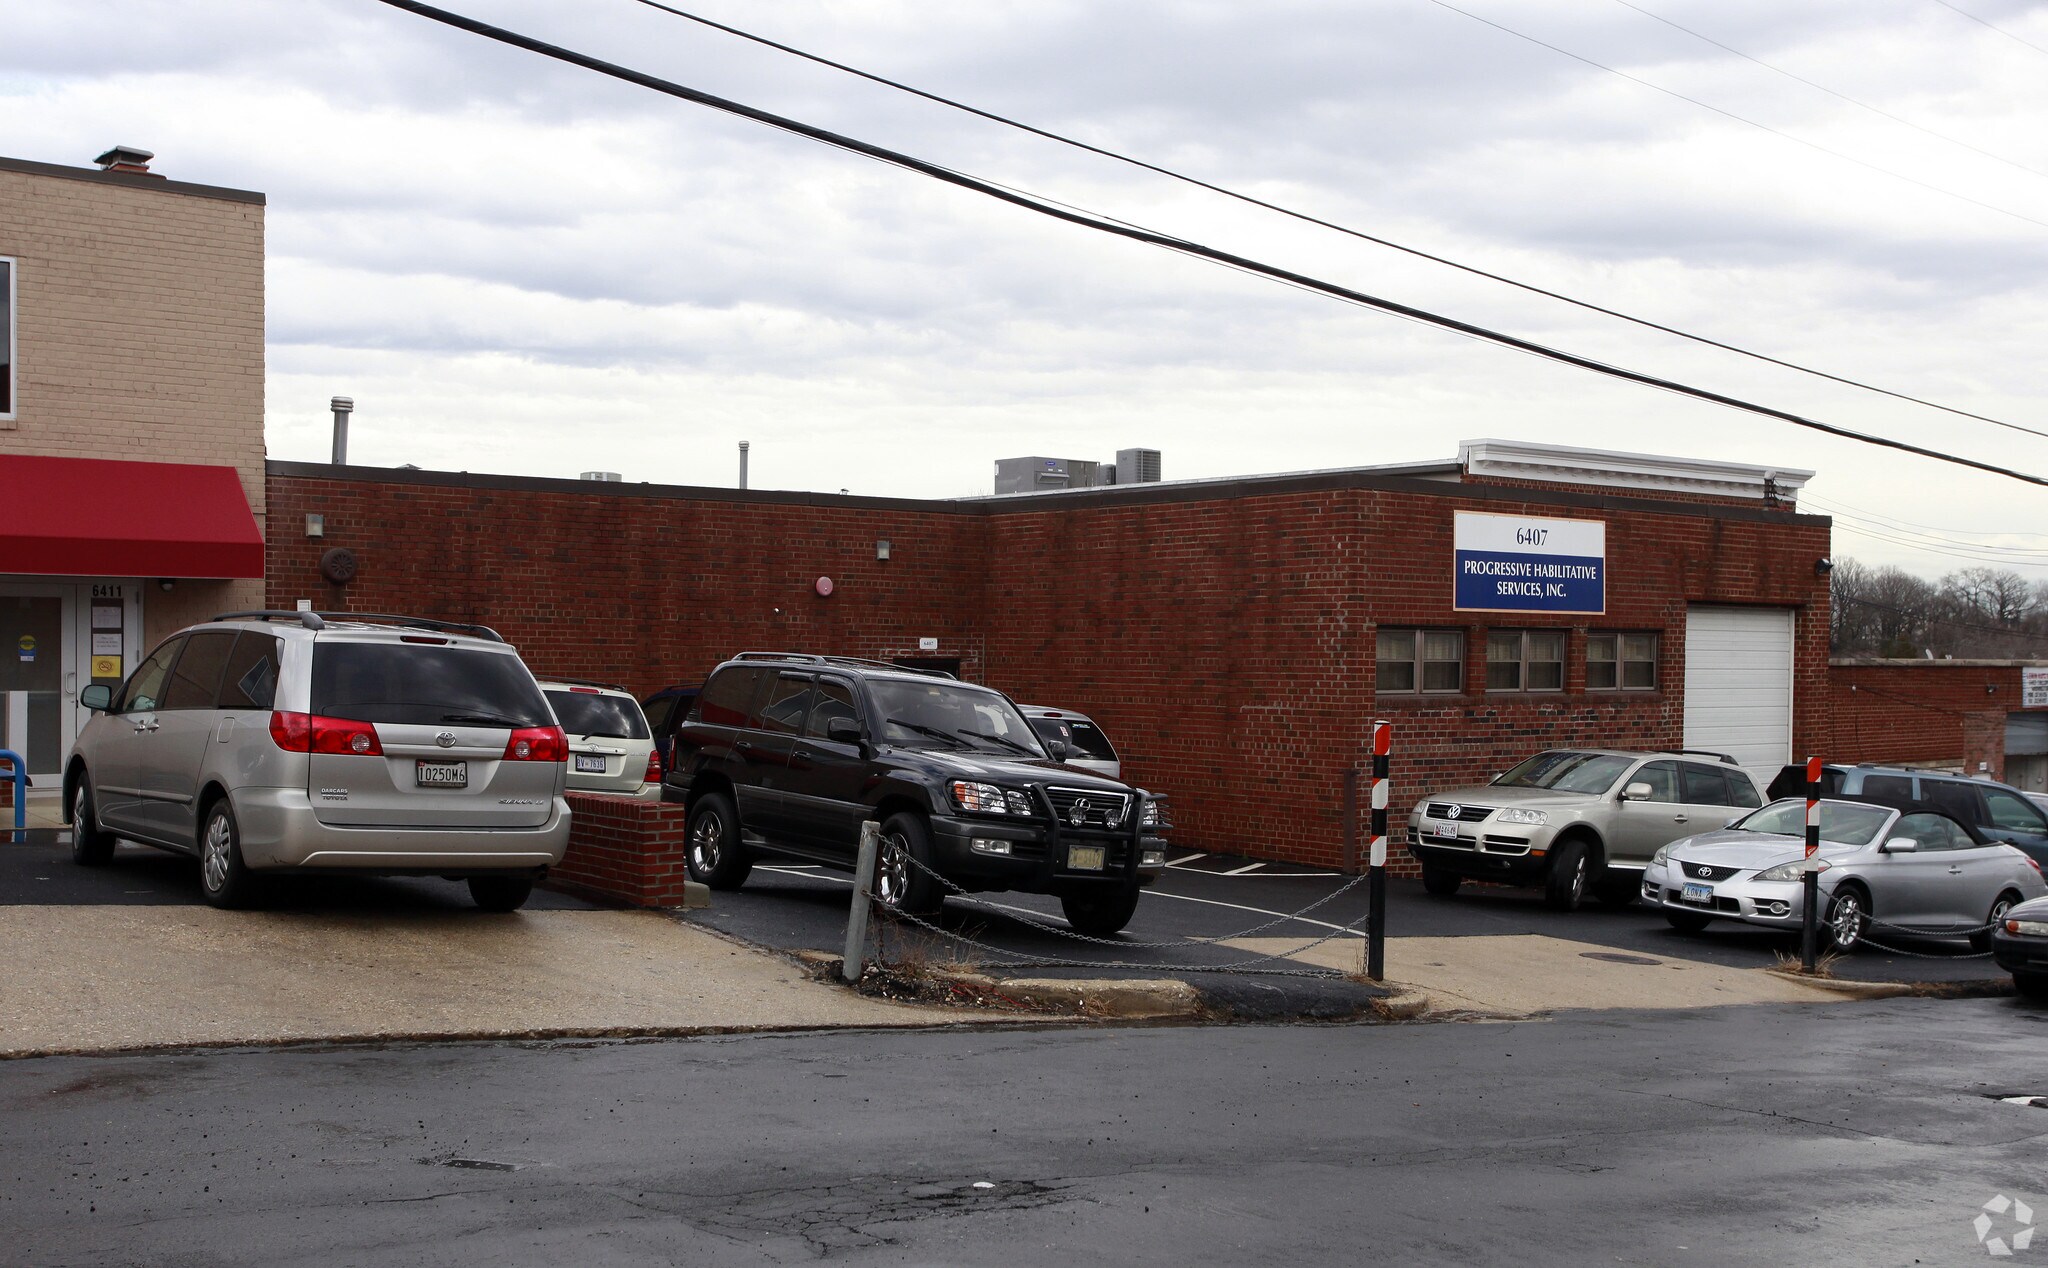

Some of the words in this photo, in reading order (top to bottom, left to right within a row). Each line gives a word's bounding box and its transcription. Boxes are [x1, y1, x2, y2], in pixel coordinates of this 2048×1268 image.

[1516, 527, 1548, 546] 6407
[1464, 560, 1531, 577] PROGRESSIVE
[1534, 563, 1596, 580] HABILITATIVE
[92, 585, 122, 597] 6411
[1496, 581, 1544, 599] SERVICES,
[1546, 583, 1567, 597] INC.
[420, 767, 465, 782] 10250M6
